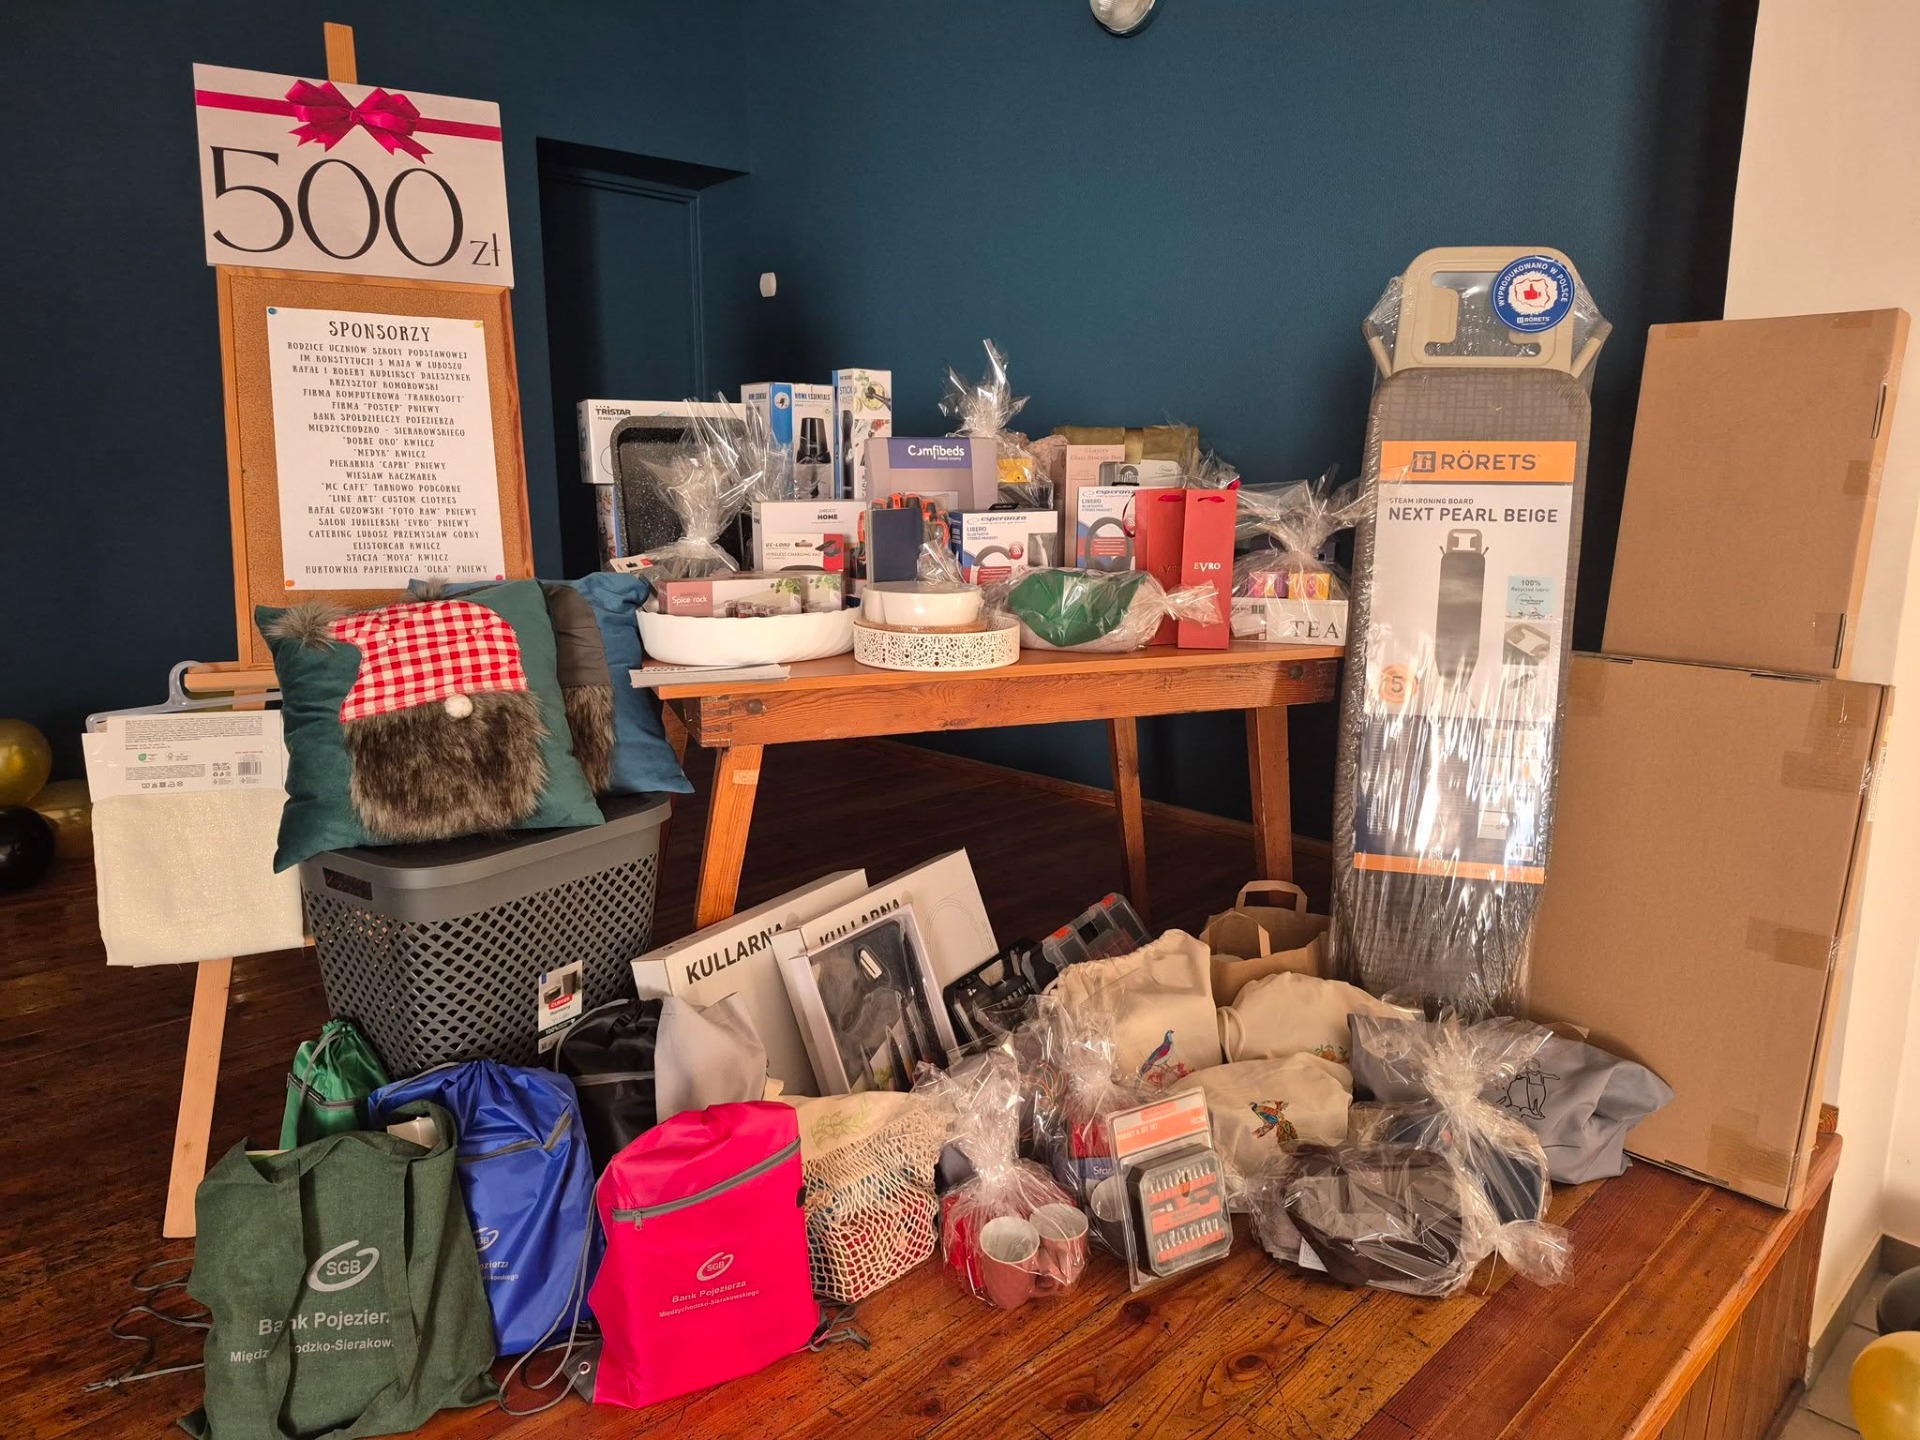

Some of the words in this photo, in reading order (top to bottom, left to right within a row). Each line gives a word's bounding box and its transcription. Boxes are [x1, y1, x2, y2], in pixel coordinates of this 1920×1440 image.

[210, 145, 464, 267] 500
[469, 232, 501, 267] zł
[1498, 262, 1548, 307] WYPRODUKOWANO
[1549, 267, 1558, 275] W
[1557, 273, 1569, 303] POLSCE
[329, 320, 430, 341] SPONSORZY
[288, 341, 324, 352] RODZICE
[329, 344, 367, 354] UCZNIÓW
[408, 349, 467, 359] PODSTAWOWEJ
[300, 354, 310, 362] IM
[316, 355, 374, 366] KONSTYTUCJI
[388, 359, 411, 368] MAJA
[428, 361, 462, 370] LUBOSZU
[333, 367, 365, 377] ROBERT
[420, 371, 471, 381] DALESZYNEK
[329, 378, 377, 388] KRZYSZTOF
[383, 381, 439, 391] KOMOROWSKI
[303, 388, 331, 398] FIRMA
[336, 390, 400, 400] KOMPUTEROWA
[331, 401, 359, 410] FIRMA
[364, 402, 403, 412] "POSTĘP"
[408, 405, 440, 413] PNIEWY
[595, 406, 631, 416] TRISTAR
[313, 412, 336, 421] BANK
[406, 416, 455, 425] POJEZIERZA
[308, 424, 380, 434] MIĘDZYCHODZKO
[394, 426, 465, 437] SIERAKOWSKIEGO
[404, 439, 435, 447] KWILCZ
[353, 448, 390, 457] "MEDYK"
[395, 450, 426, 458] KWILCZ
[907, 445, 965, 460] Comfibeds
[329, 459, 375, 468] PIEKARNIA
[415, 461, 446, 470] PNIEWY
[1441, 450, 1536, 471] RÖRETS
[388, 472, 437, 481] KACZMAREK
[373, 483, 414, 492] TARNOWO
[382, 495, 416, 503] CUSTOM
[421, 496, 457, 504] CLOTHES
[340, 506, 384, 515] GUZOWSKI
[445, 507, 477, 516] PNIEWY
[1388, 507, 1434, 521] NEXT
[1440, 508, 1498, 522] PEARL
[1504, 508, 1558, 523] BEIGE
[319, 518, 346, 526] SALON
[351, 518, 399, 527] JUBILERSKI
[437, 519, 469, 527] PNIEWY
[308, 529, 352, 538] CATERING
[357, 530, 388, 538] LUBOSZ
[353, 542, 405, 550] ELISTORCAR
[409, 542, 441, 550] KWILCZ
[346, 553, 378, 562] STACJA
[305, 565, 358, 574] HURTOWNIA
[363, 565, 419, 574] PAPIERNICZA
[456, 565, 488, 574] PNIEWY
[1193, 562, 1221, 572] EVRO
[671, 596, 691, 606] Spice
[1290, 620, 1339, 639] TEA
[1391, 675, 1403, 693] 5
[326, 1260, 362, 1276] SGB
[706, 1261, 725, 1272] SGB
[671, 1293, 697, 1303] Bank
[699, 1280, 747, 1298] Pojezierza
[659, 1289, 760, 1318] Międzychodzko-Sierakowskiego
[314, 1309, 390, 1330] Pojezier
